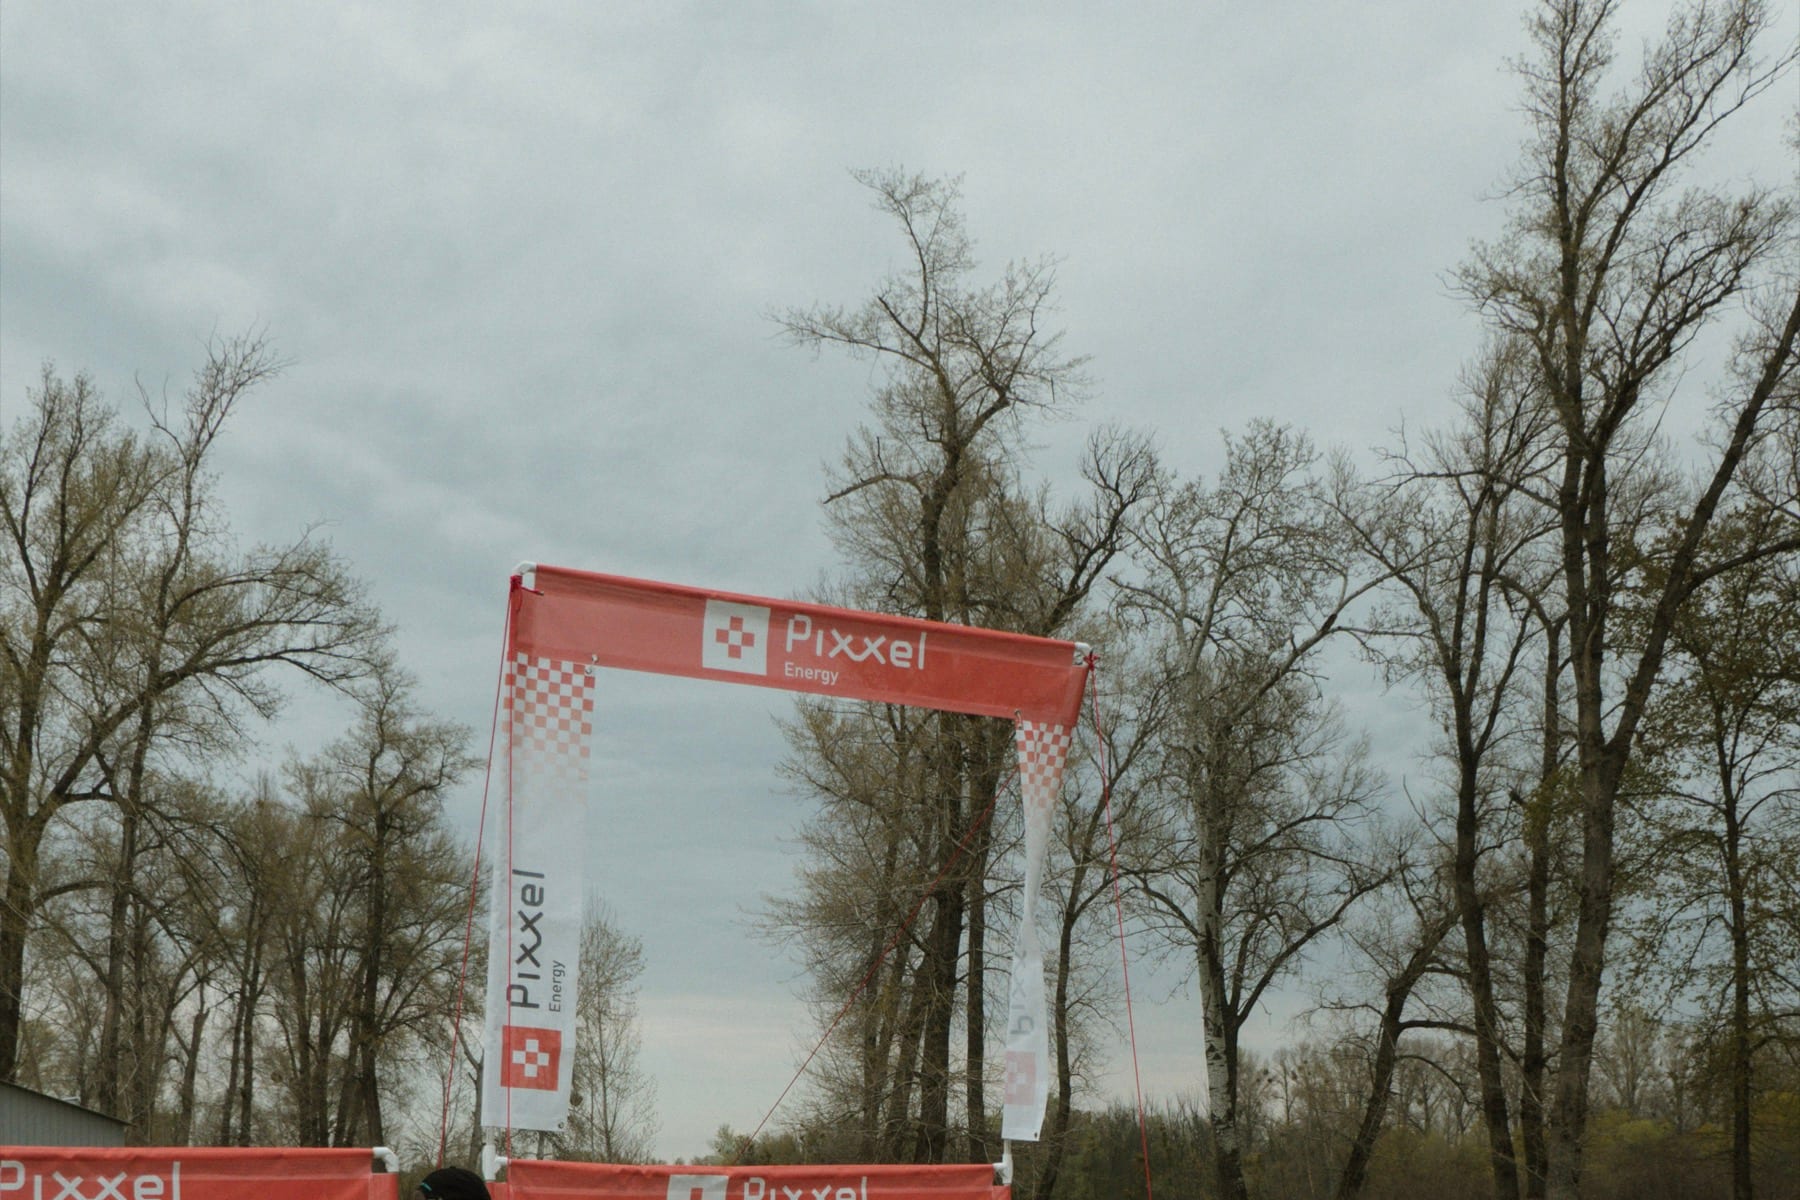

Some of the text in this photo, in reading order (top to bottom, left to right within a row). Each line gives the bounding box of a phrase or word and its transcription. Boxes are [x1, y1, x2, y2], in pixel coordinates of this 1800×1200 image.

[786, 614, 927, 670] Pixxel
[784, 661, 839, 686] Energy
[506, 868, 545, 1009] Pixxel
[548, 960, 566, 1012] Energy
